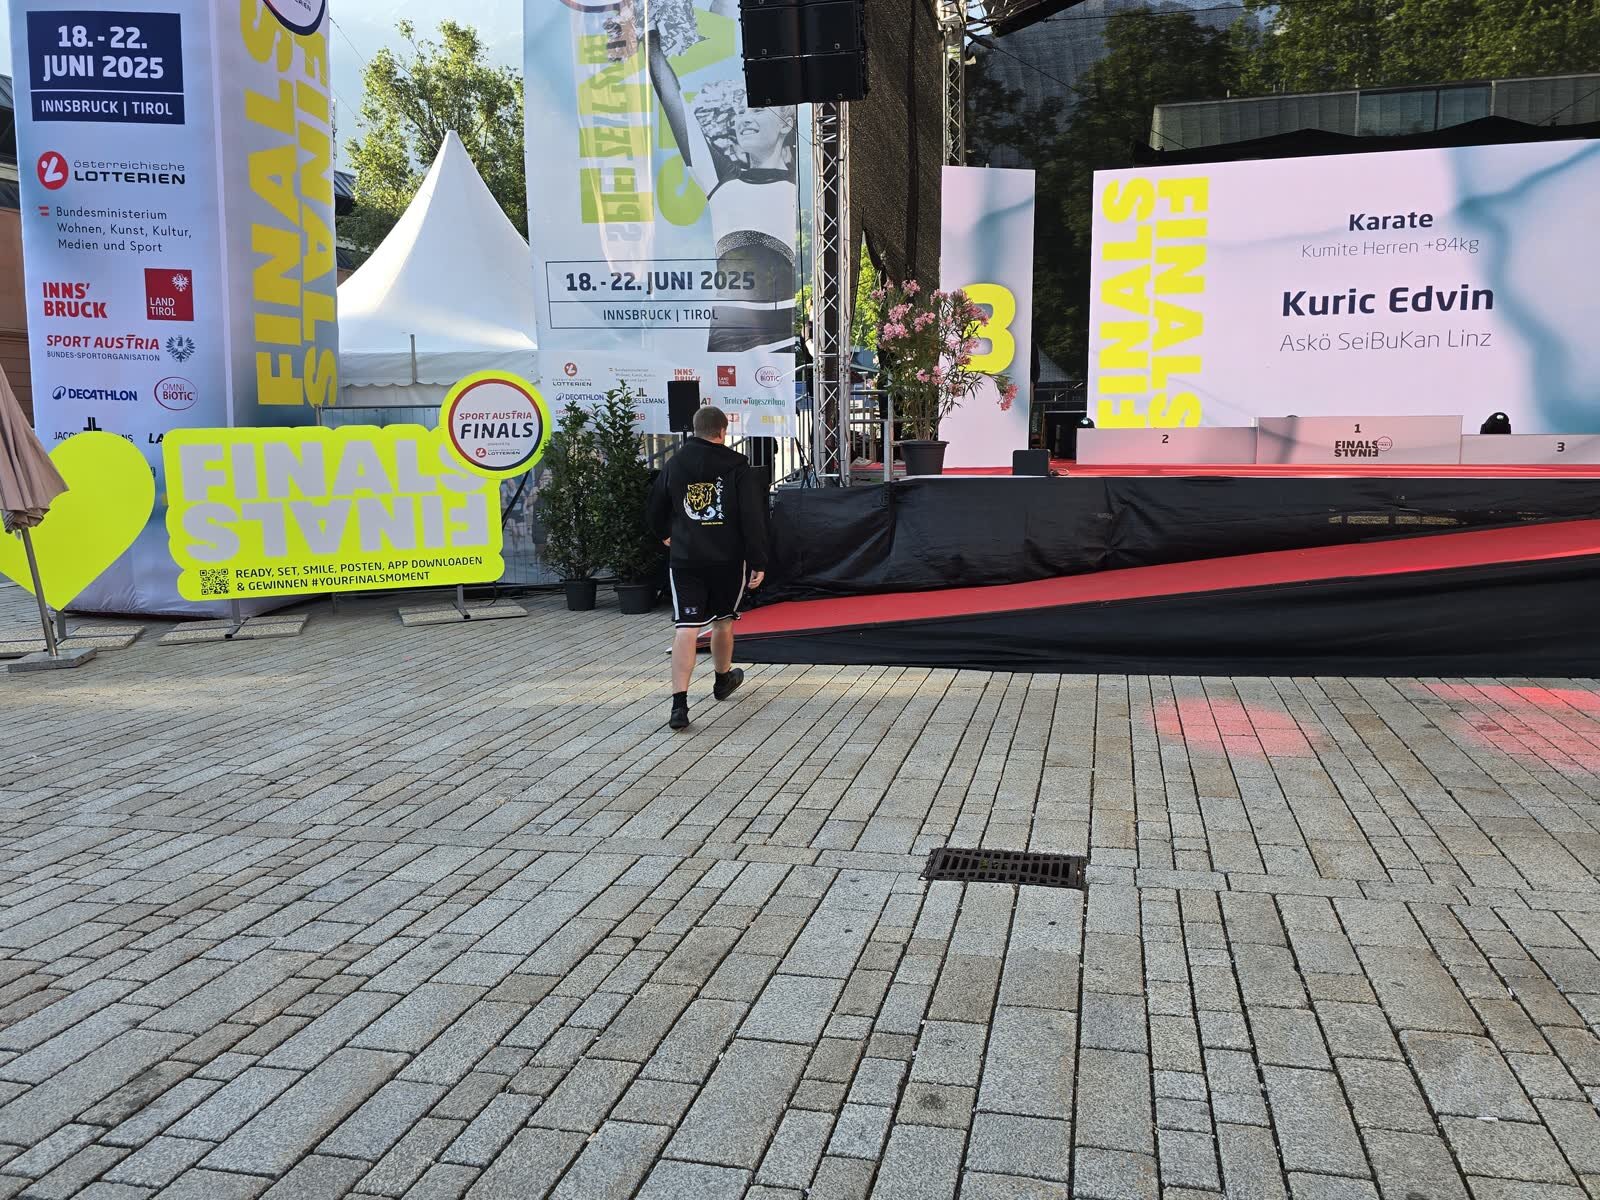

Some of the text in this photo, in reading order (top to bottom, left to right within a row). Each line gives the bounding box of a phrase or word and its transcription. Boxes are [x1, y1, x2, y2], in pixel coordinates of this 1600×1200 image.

[43, 55, 164, 81] JUNI 2025
[41, 99, 119, 113] INNSBRUCK
[131, 101, 173, 115] TIROL
[73, 160, 185, 172] österreichische
[74, 170, 186, 185] LOTTERIEN
[56, 206, 167, 220] Bundesministerium
[1349, 212, 1434, 231] Karate
[57, 222, 192, 239] Wohnen, Kunst, Kultur,
[58, 238, 163, 254] Medien und Sport
[1302, 236, 1480, 258] Kumite Herren +84kg
[646, 271, 693, 295] JUNI
[700, 270, 755, 290] 2025
[150, 297, 175, 307] LAND
[1096, 177, 1156, 428] FINALS
[1148, 176, 1209, 428] FINALS
[1282, 284, 1494, 317] Kuric Edvin
[44, 300, 108, 318] BRUCK
[150, 306, 177, 316] TIROL
[603, 309, 671, 320] INNSBRUCK
[683, 308, 719, 320] TIROL
[46, 334, 160, 349] SPORT AUSTRIA
[1279, 329, 1492, 352] Askö SeiBuKan Linz
[46, 351, 160, 361] BUNDES-SPORTORGANISATION
[68, 388, 138, 401] DECATHLON
[565, 393, 605, 401] DECATHLON
[459, 411, 532, 420] SPORT AUSTRIA
[460, 422, 534, 439] FINALS
[1354, 423, 1361, 433] 1
[1161, 434, 1169, 444] 2
[1334, 440, 1379, 449] FINALS
[1556, 441, 1566, 452] 3
[1334, 448, 1379, 457] FINALS
[178, 437, 488, 501] FINALS
[182, 491, 490, 563] FINALS
[236, 556, 483, 578] READY, SET, SMILE, POSTEN, APP DOWNLOADEN
[236, 571, 430, 591] & GEWINNEN #YOURFINALSMOMENT
